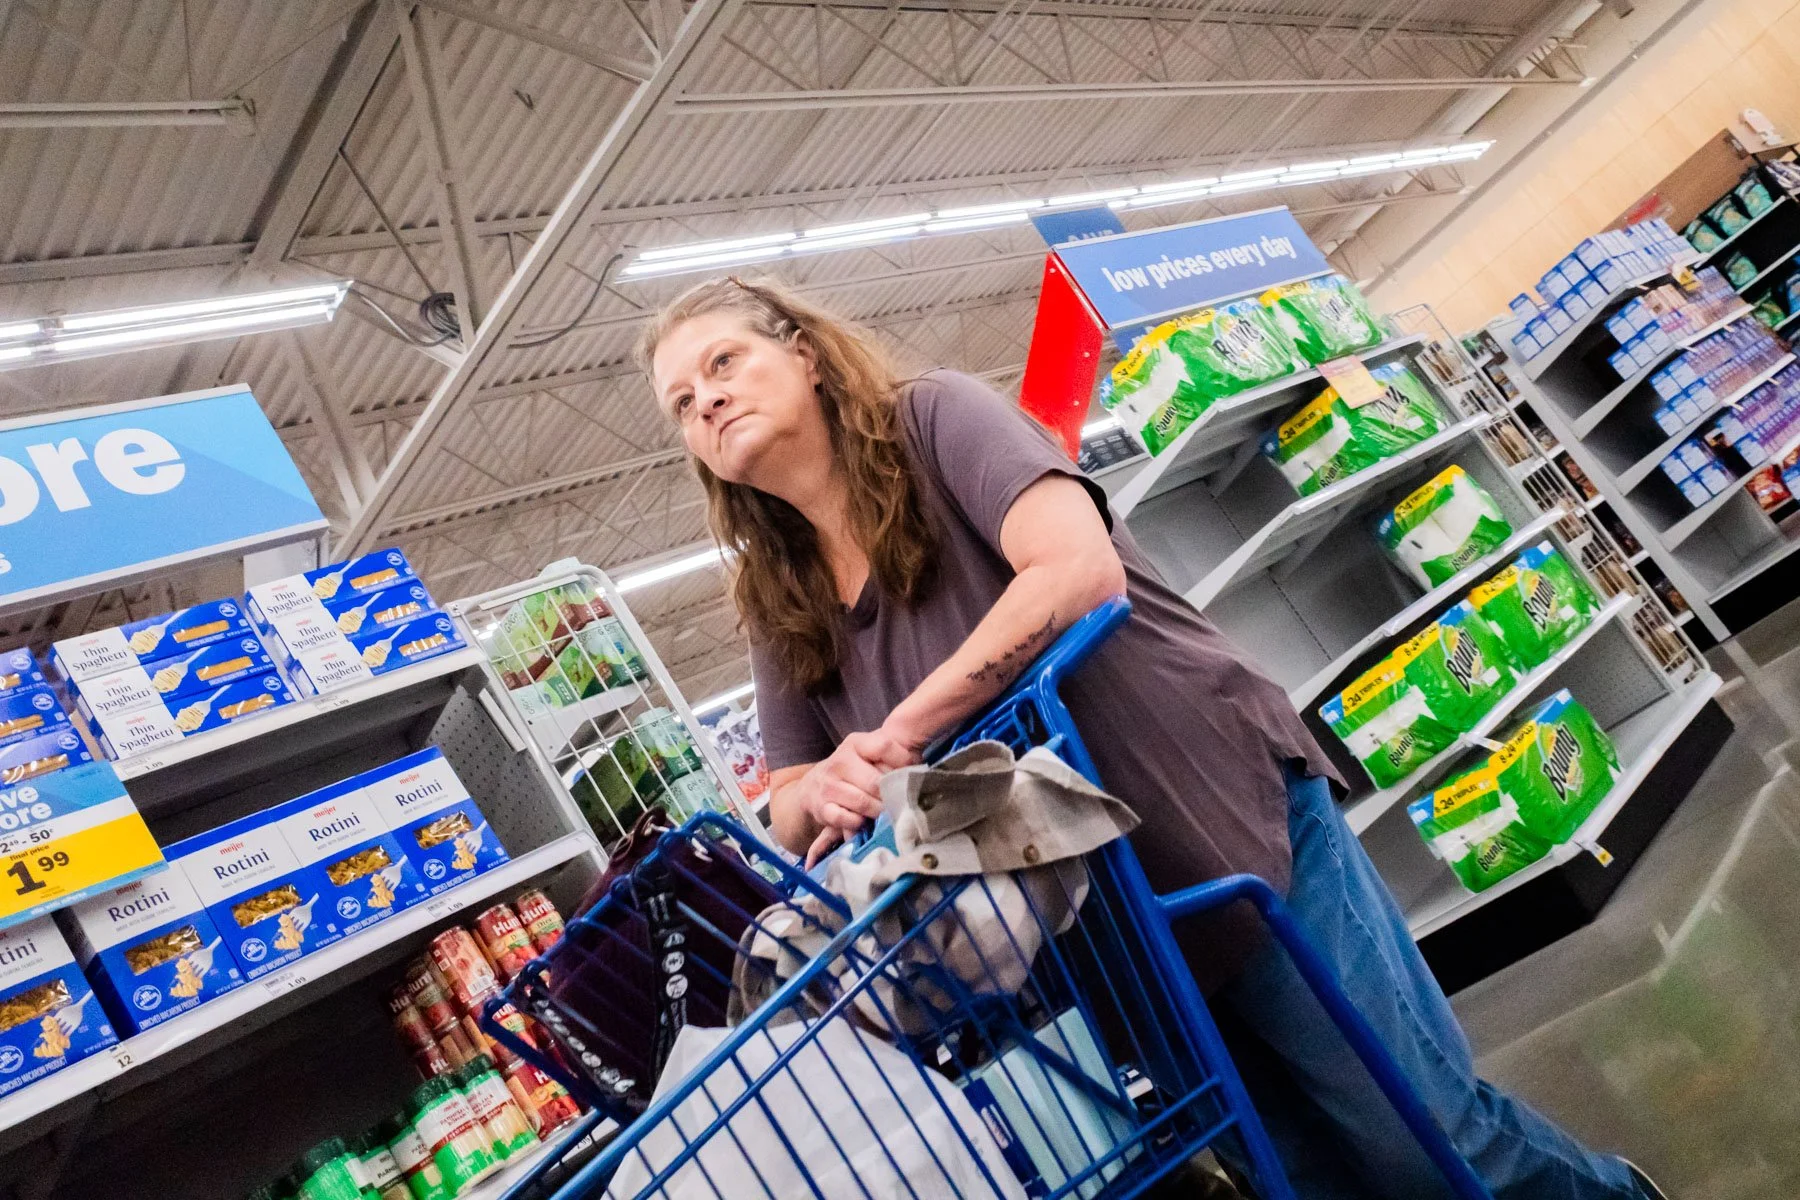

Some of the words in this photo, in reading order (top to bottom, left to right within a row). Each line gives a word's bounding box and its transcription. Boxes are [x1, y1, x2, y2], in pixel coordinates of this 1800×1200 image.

[1101, 266, 1149, 293] low
[1146, 254, 1213, 289] prices
[1209, 243, 1267, 267] every
[1259, 235, 1298, 259] day
[266, 595, 313, 614] Spaghetti
[273, 590, 297, 602] Thin
[291, 629, 338, 650] Spaghetti
[298, 625, 321, 637] Thin
[72, 650, 128, 672] Spaghetti
[82, 646, 109, 659] Thin
[1446, 630, 1480, 694] Bounty
[316, 664, 363, 684] Spaghetti
[323, 659, 347, 672] Thin
[95, 688, 152, 711] Spaghetti
[105, 684, 132, 698] Thin
[119, 727, 175, 751] Spaghetti
[129, 723, 156, 737] Thin
[1543, 723, 1582, 801] Bounty
[395, 779, 443, 807] Rotini
[313, 806, 336, 819] meijer
[308, 811, 361, 842] Rotini
[10, 850, 29, 861] final
[30, 844, 50, 856] price
[220, 841, 245, 855] meijer
[213, 848, 270, 880] Rotini
[115, 881, 143, 896] meijer
[108, 887, 170, 922] Rotini
[179, 995, 201, 1012] PRODUCT
[116, 1054, 134, 1069] 12
